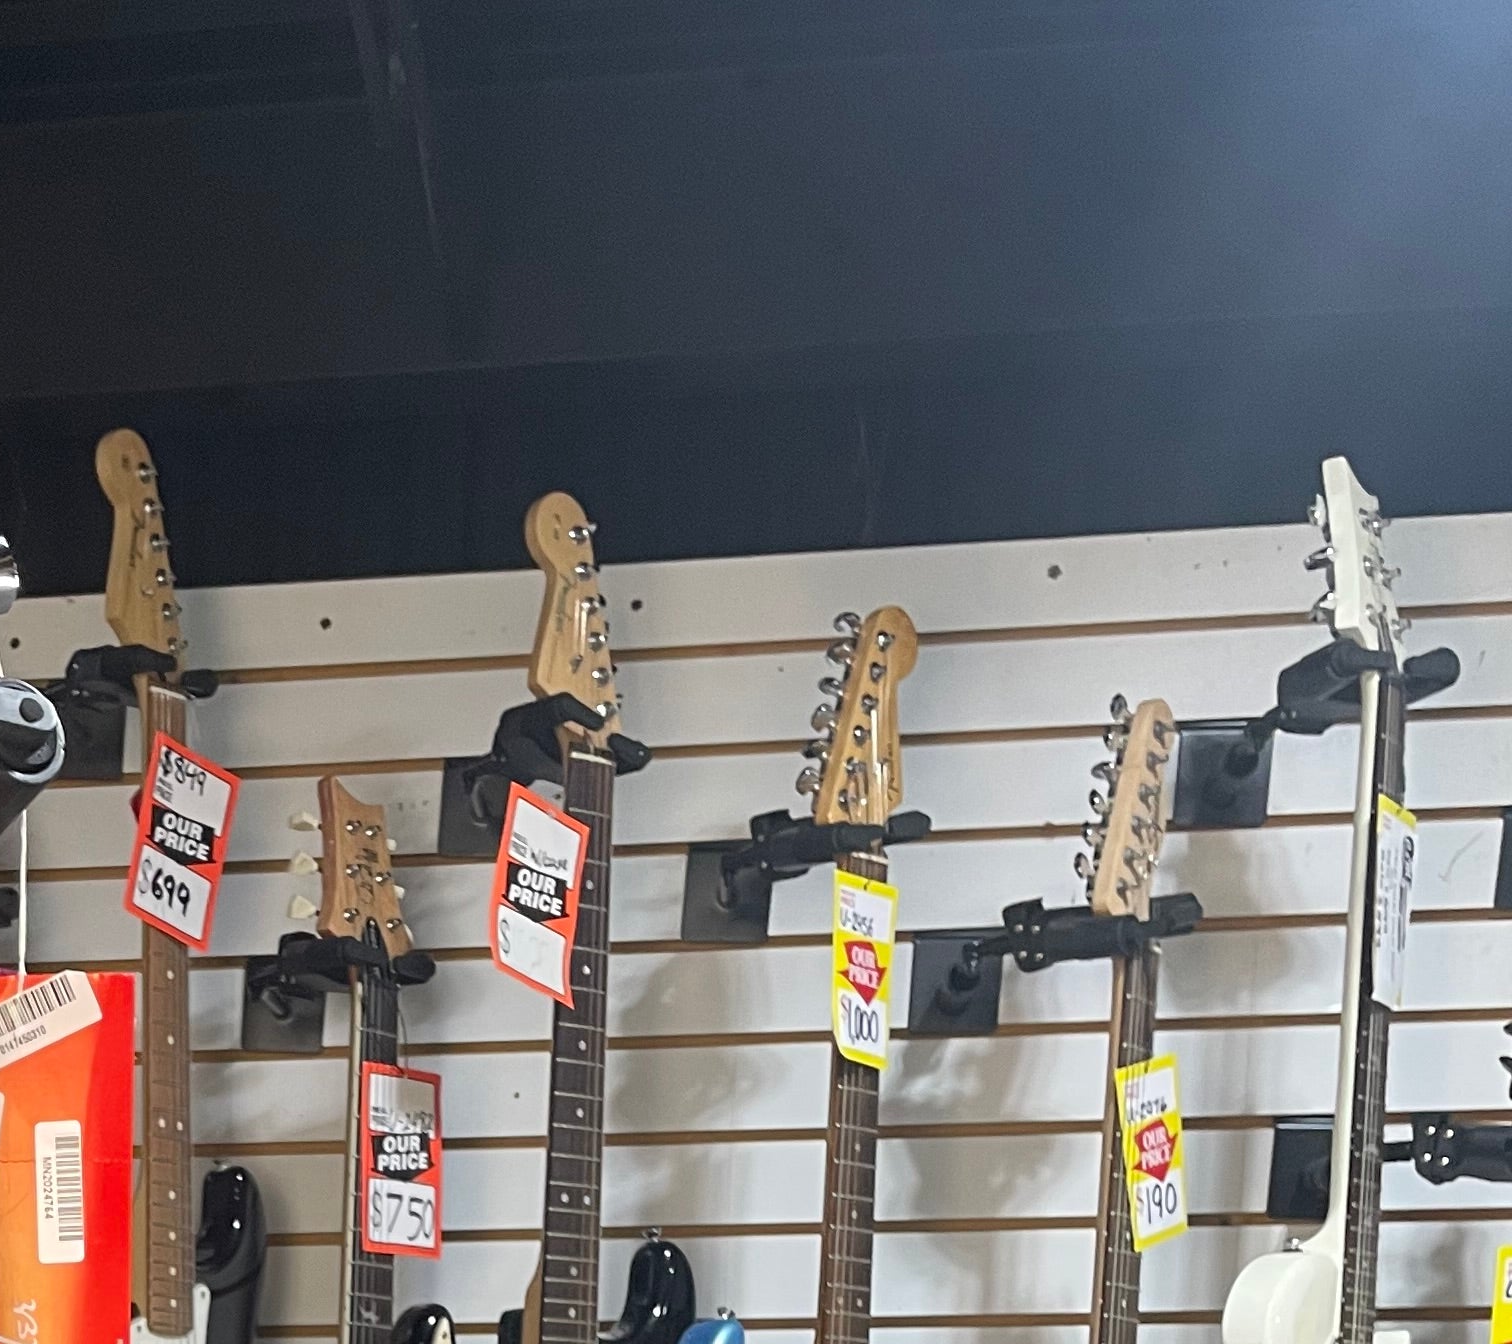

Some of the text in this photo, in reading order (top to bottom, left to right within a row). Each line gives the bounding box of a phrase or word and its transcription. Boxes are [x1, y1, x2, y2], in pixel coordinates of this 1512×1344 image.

[162, 811, 203, 841] OUR
[153, 826, 211, 862] PRICE
[138, 858, 191, 918] $699
[516, 868, 558, 896] OUR
[508, 883, 565, 917] PRICE
[851, 945, 877, 970] OUR
[848, 963, 881, 990] PRICE
[382, 1135, 423, 1153] OUR
[1141, 1125, 1169, 1150] OUR
[376, 1152, 430, 1172] PRICE
[1140, 1140, 1173, 1171] PRICE
[372, 1191, 435, 1242] $750
